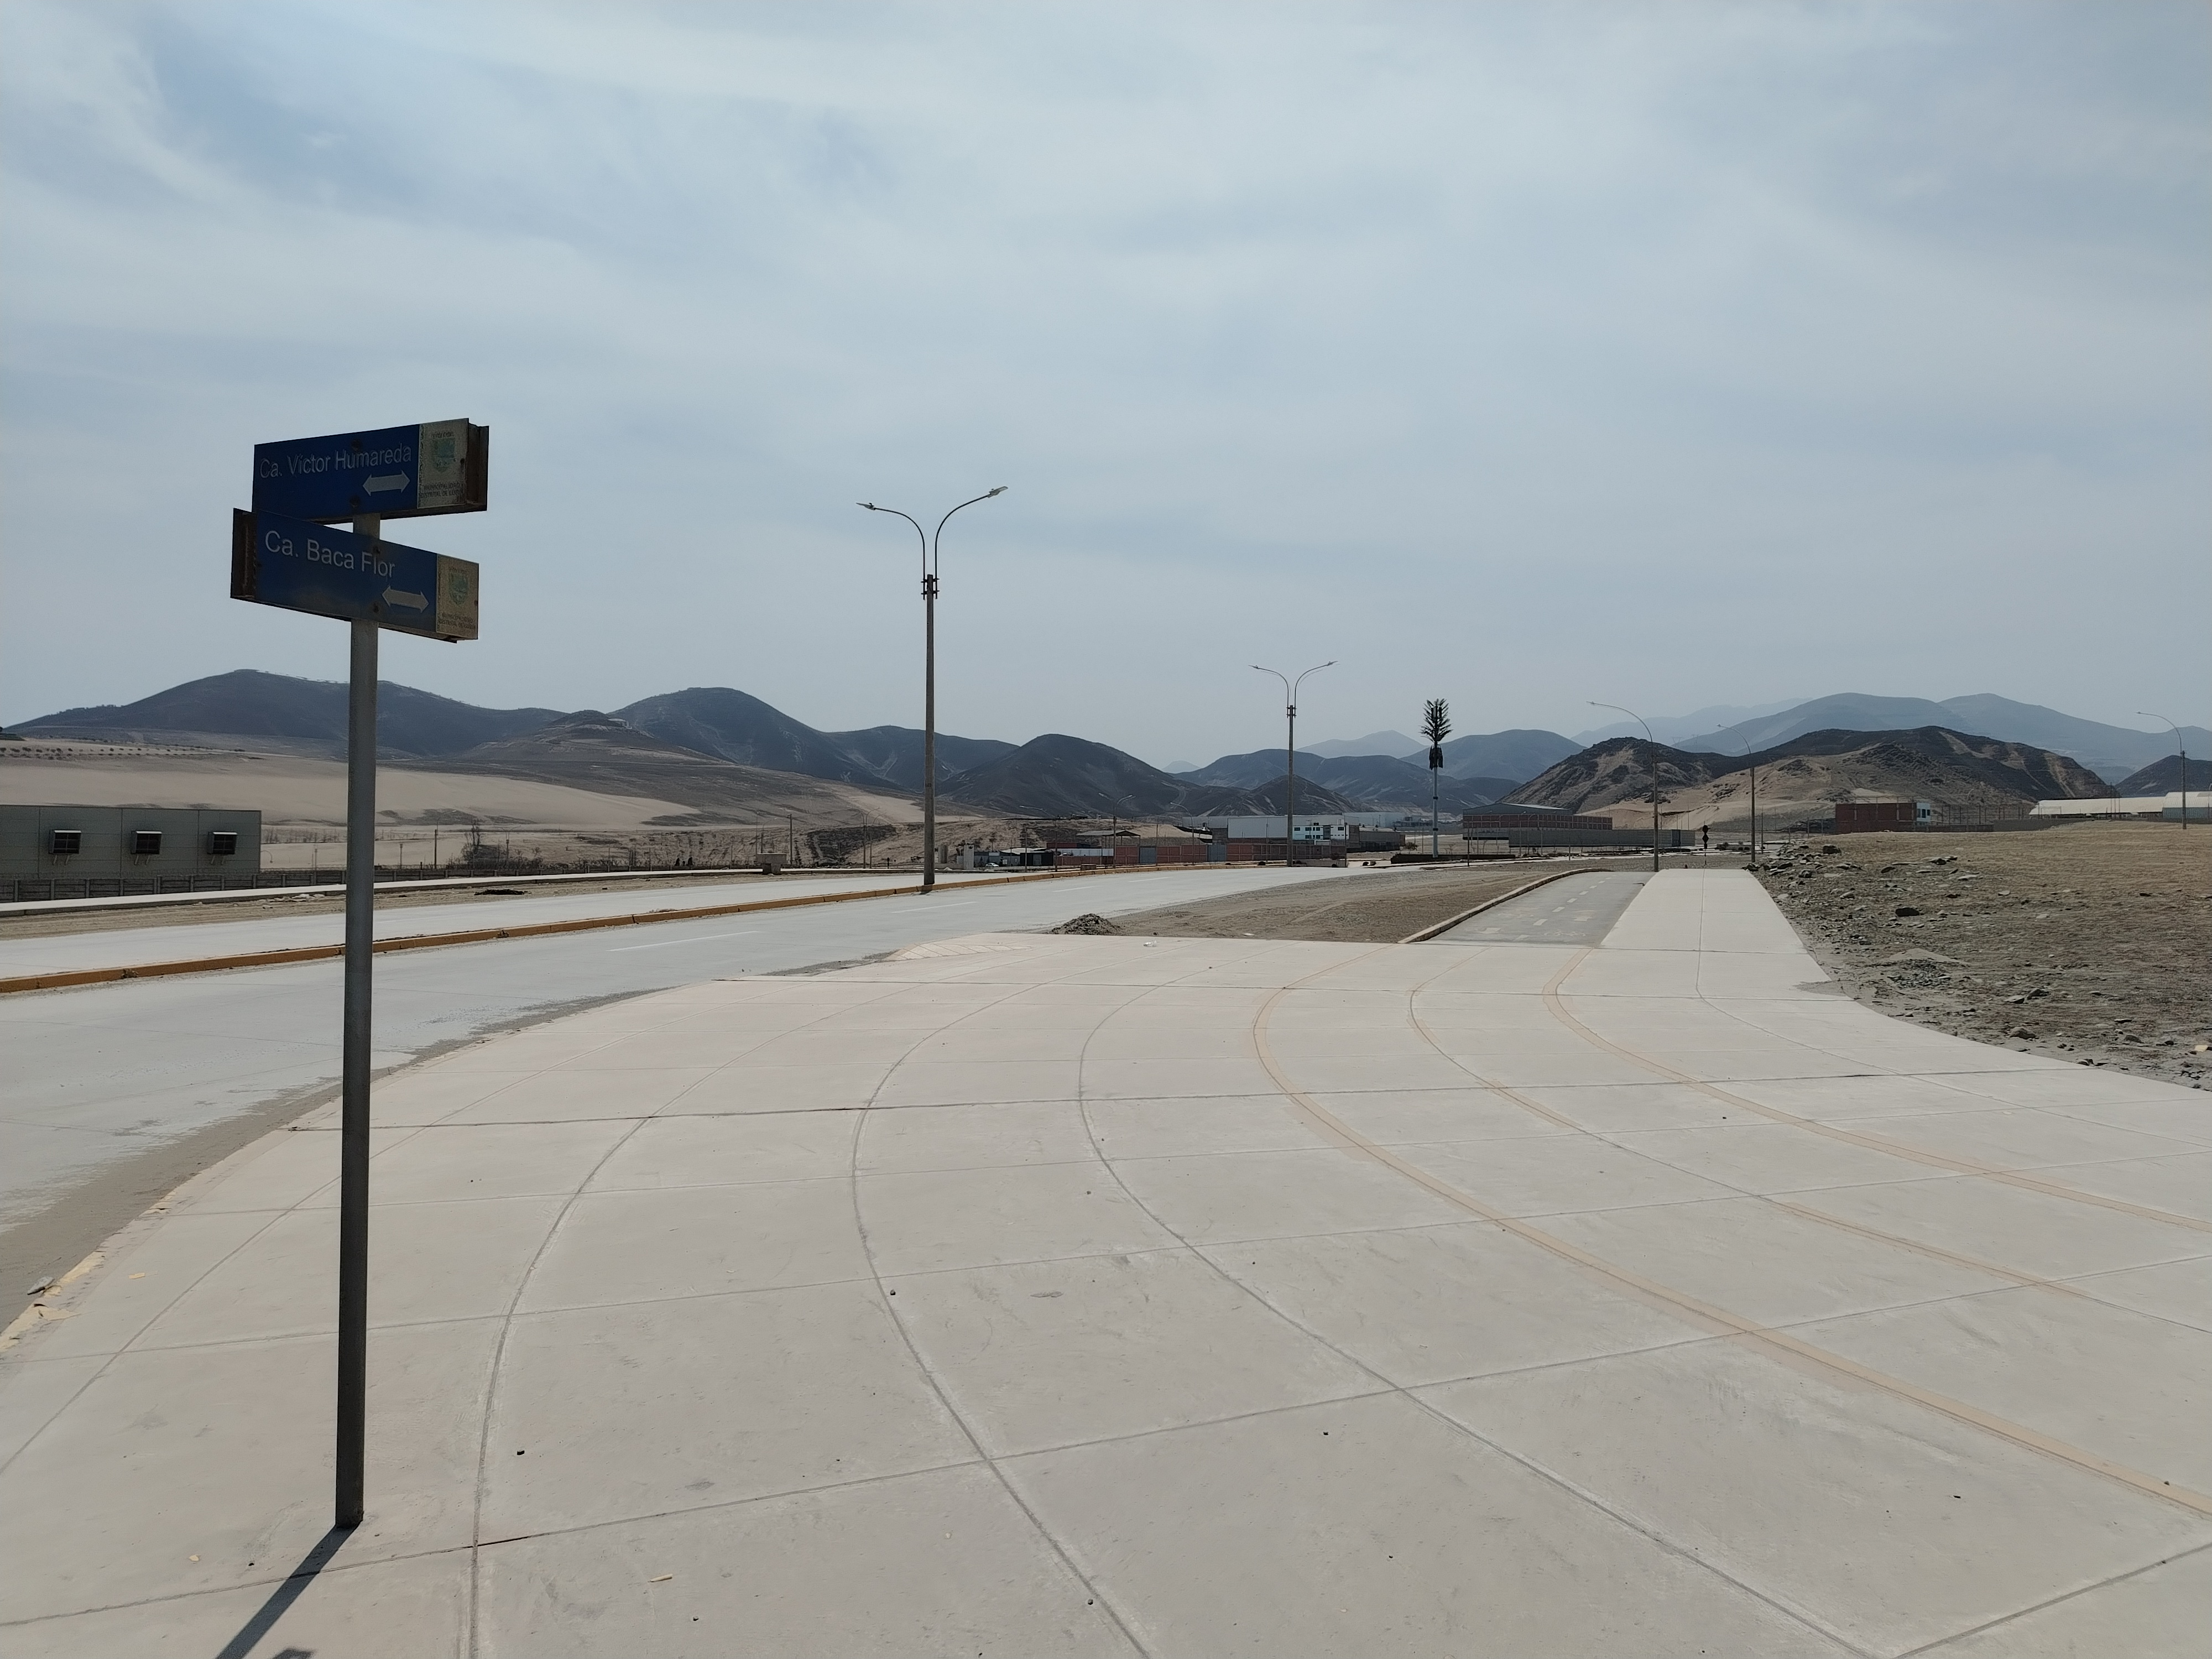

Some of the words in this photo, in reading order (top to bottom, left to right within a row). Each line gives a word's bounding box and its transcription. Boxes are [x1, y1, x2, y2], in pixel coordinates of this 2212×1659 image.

[260, 458, 283, 478] Ca.
[335, 441, 412, 470] Humareda
[265, 530, 299, 557] Ca.
[306, 538, 354, 570] Baca
[361, 550, 395, 578] Flor
